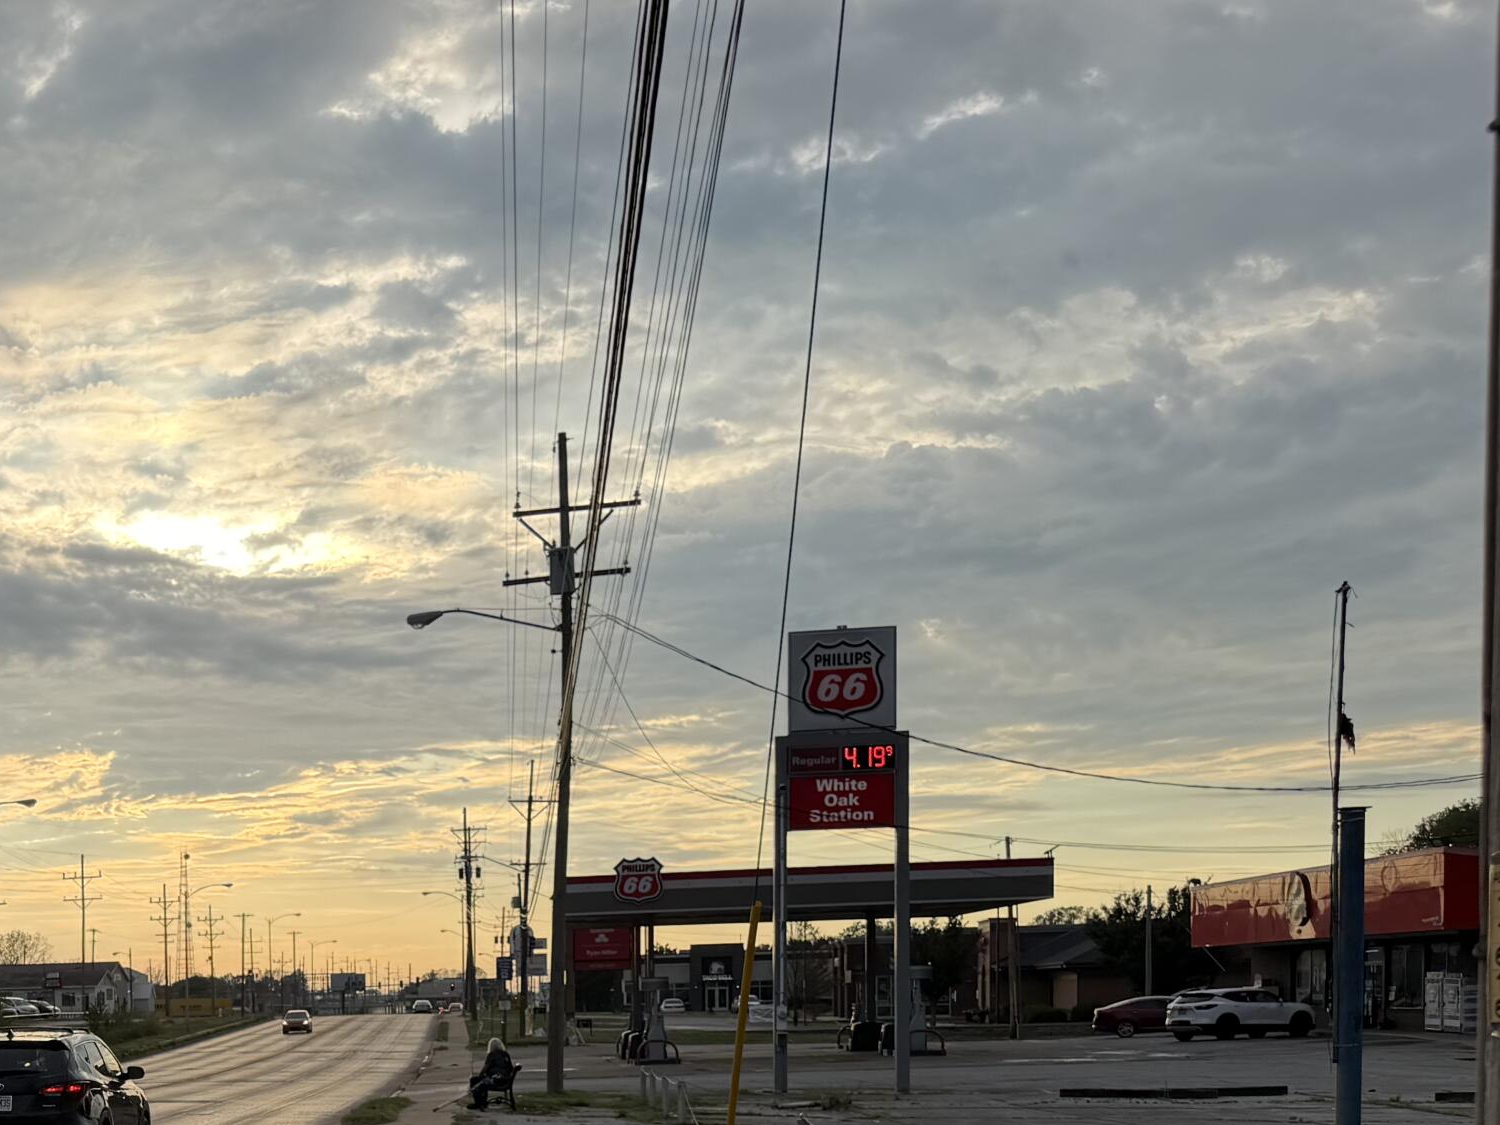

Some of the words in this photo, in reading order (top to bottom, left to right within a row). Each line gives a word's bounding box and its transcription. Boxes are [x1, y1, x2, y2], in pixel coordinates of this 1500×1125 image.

[814, 651, 872, 668] PHILLIPS
[817, 672, 869, 703] 66
[792, 755, 837, 768] Regular
[816, 778, 867, 792] White
[824, 793, 859, 807] Oak
[809, 808, 875, 823] Station
[622, 864, 656, 872] PHILLIPS
[623, 875, 654, 894] 66
